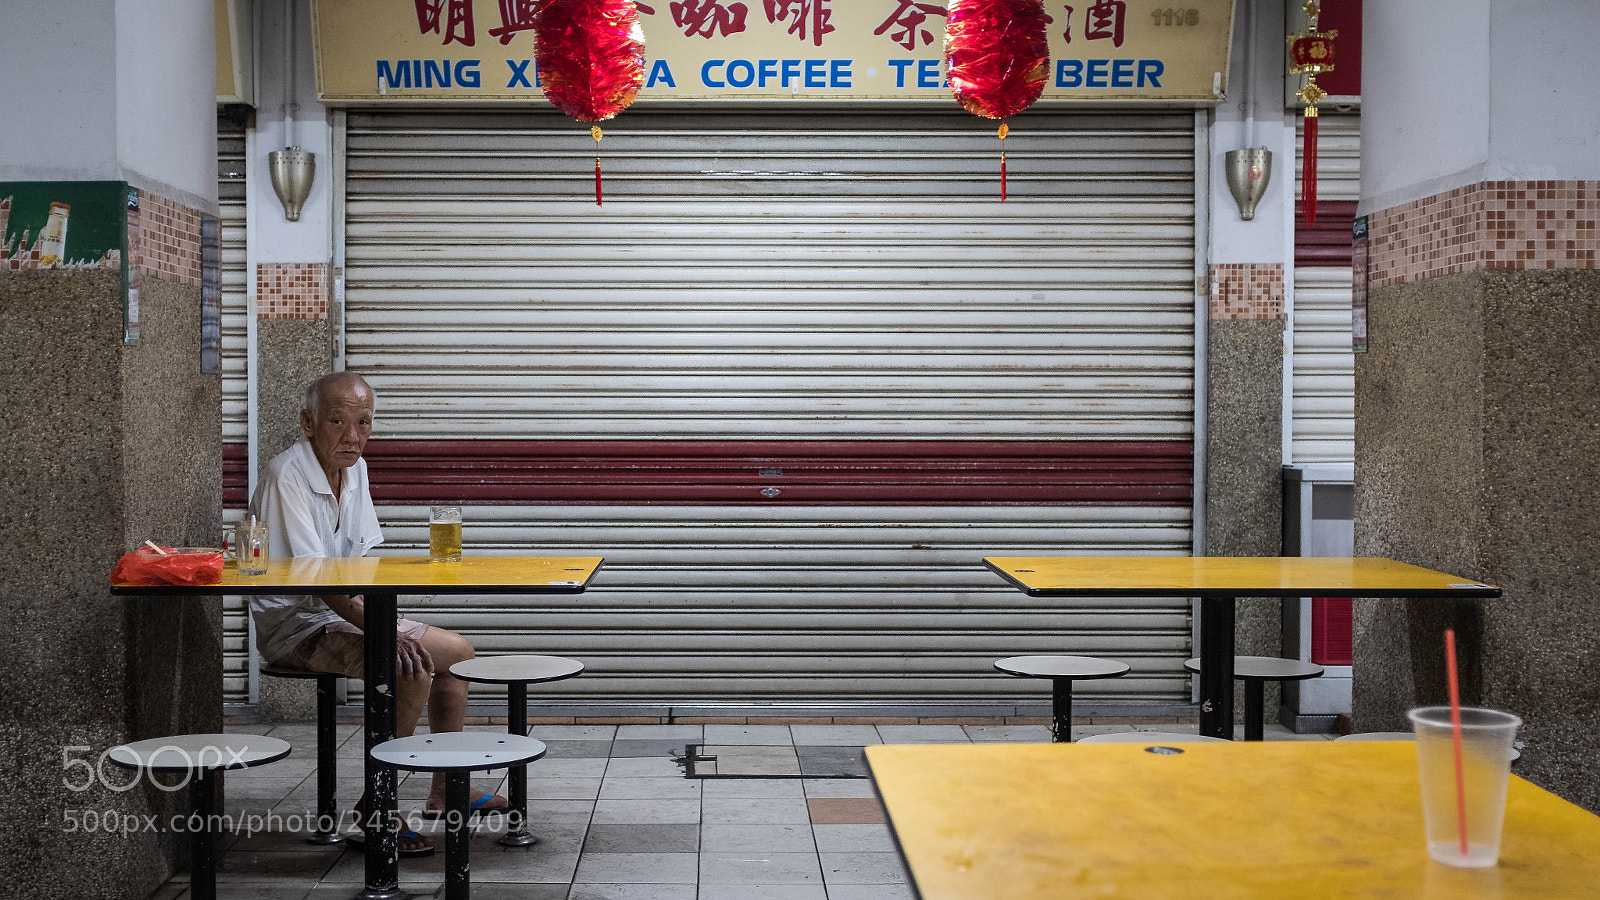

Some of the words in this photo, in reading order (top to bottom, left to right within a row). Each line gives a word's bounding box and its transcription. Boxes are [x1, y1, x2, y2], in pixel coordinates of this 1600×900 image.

[1151, 8, 1199, 26] 1116
[376, 60, 481, 88] MING
[701, 59, 853, 88] COFFEE
[888, 59, 950, 88] TE
[1055, 59, 1165, 88] BEER
